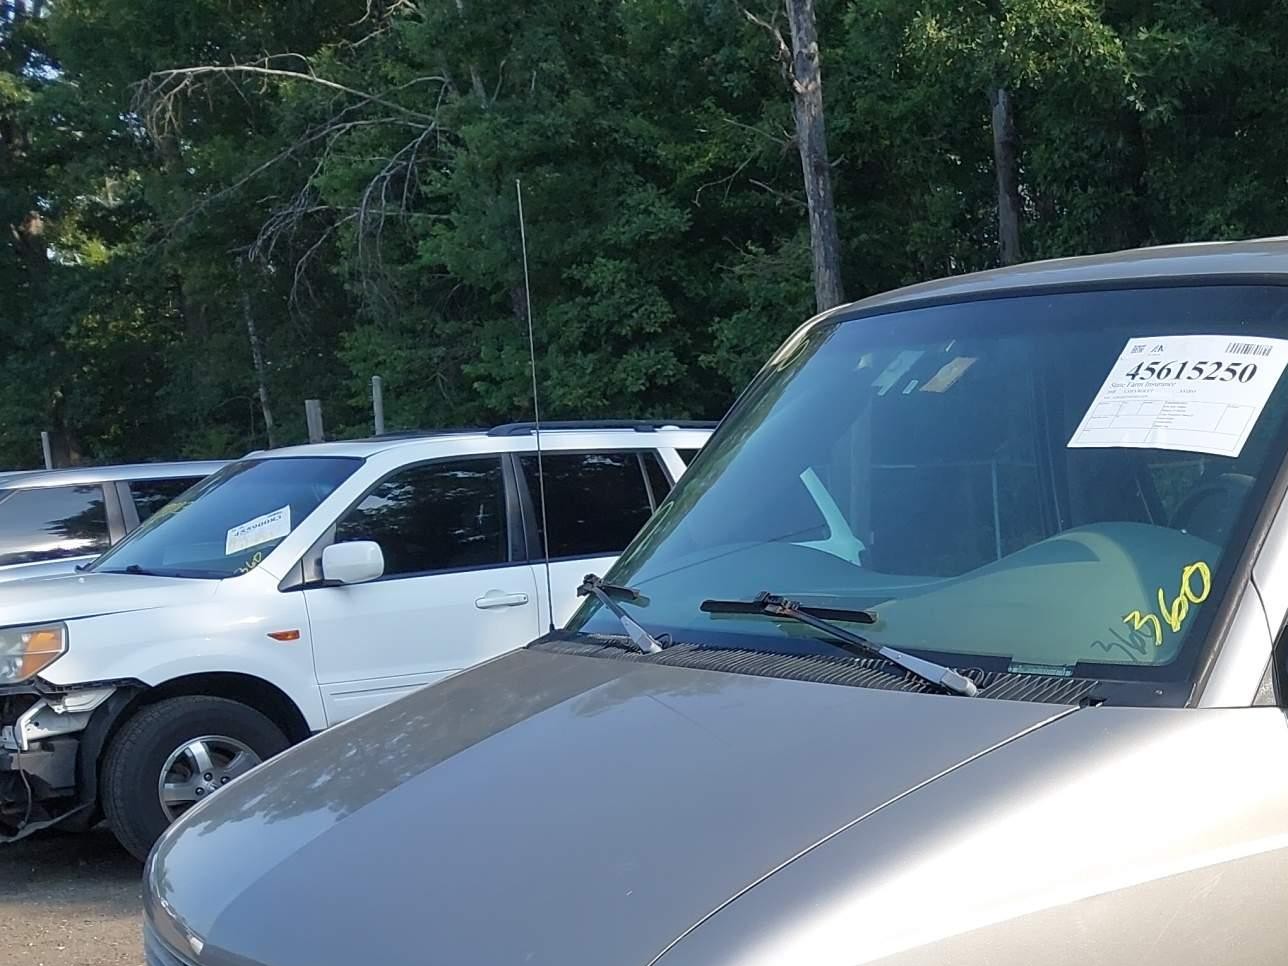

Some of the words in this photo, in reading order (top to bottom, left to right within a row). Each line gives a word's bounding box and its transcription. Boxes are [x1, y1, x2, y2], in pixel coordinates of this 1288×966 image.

[1126, 360, 1257, 383] 45615250
[233, 551, 263, 575] 360
[1122, 560, 1212, 646] 360
